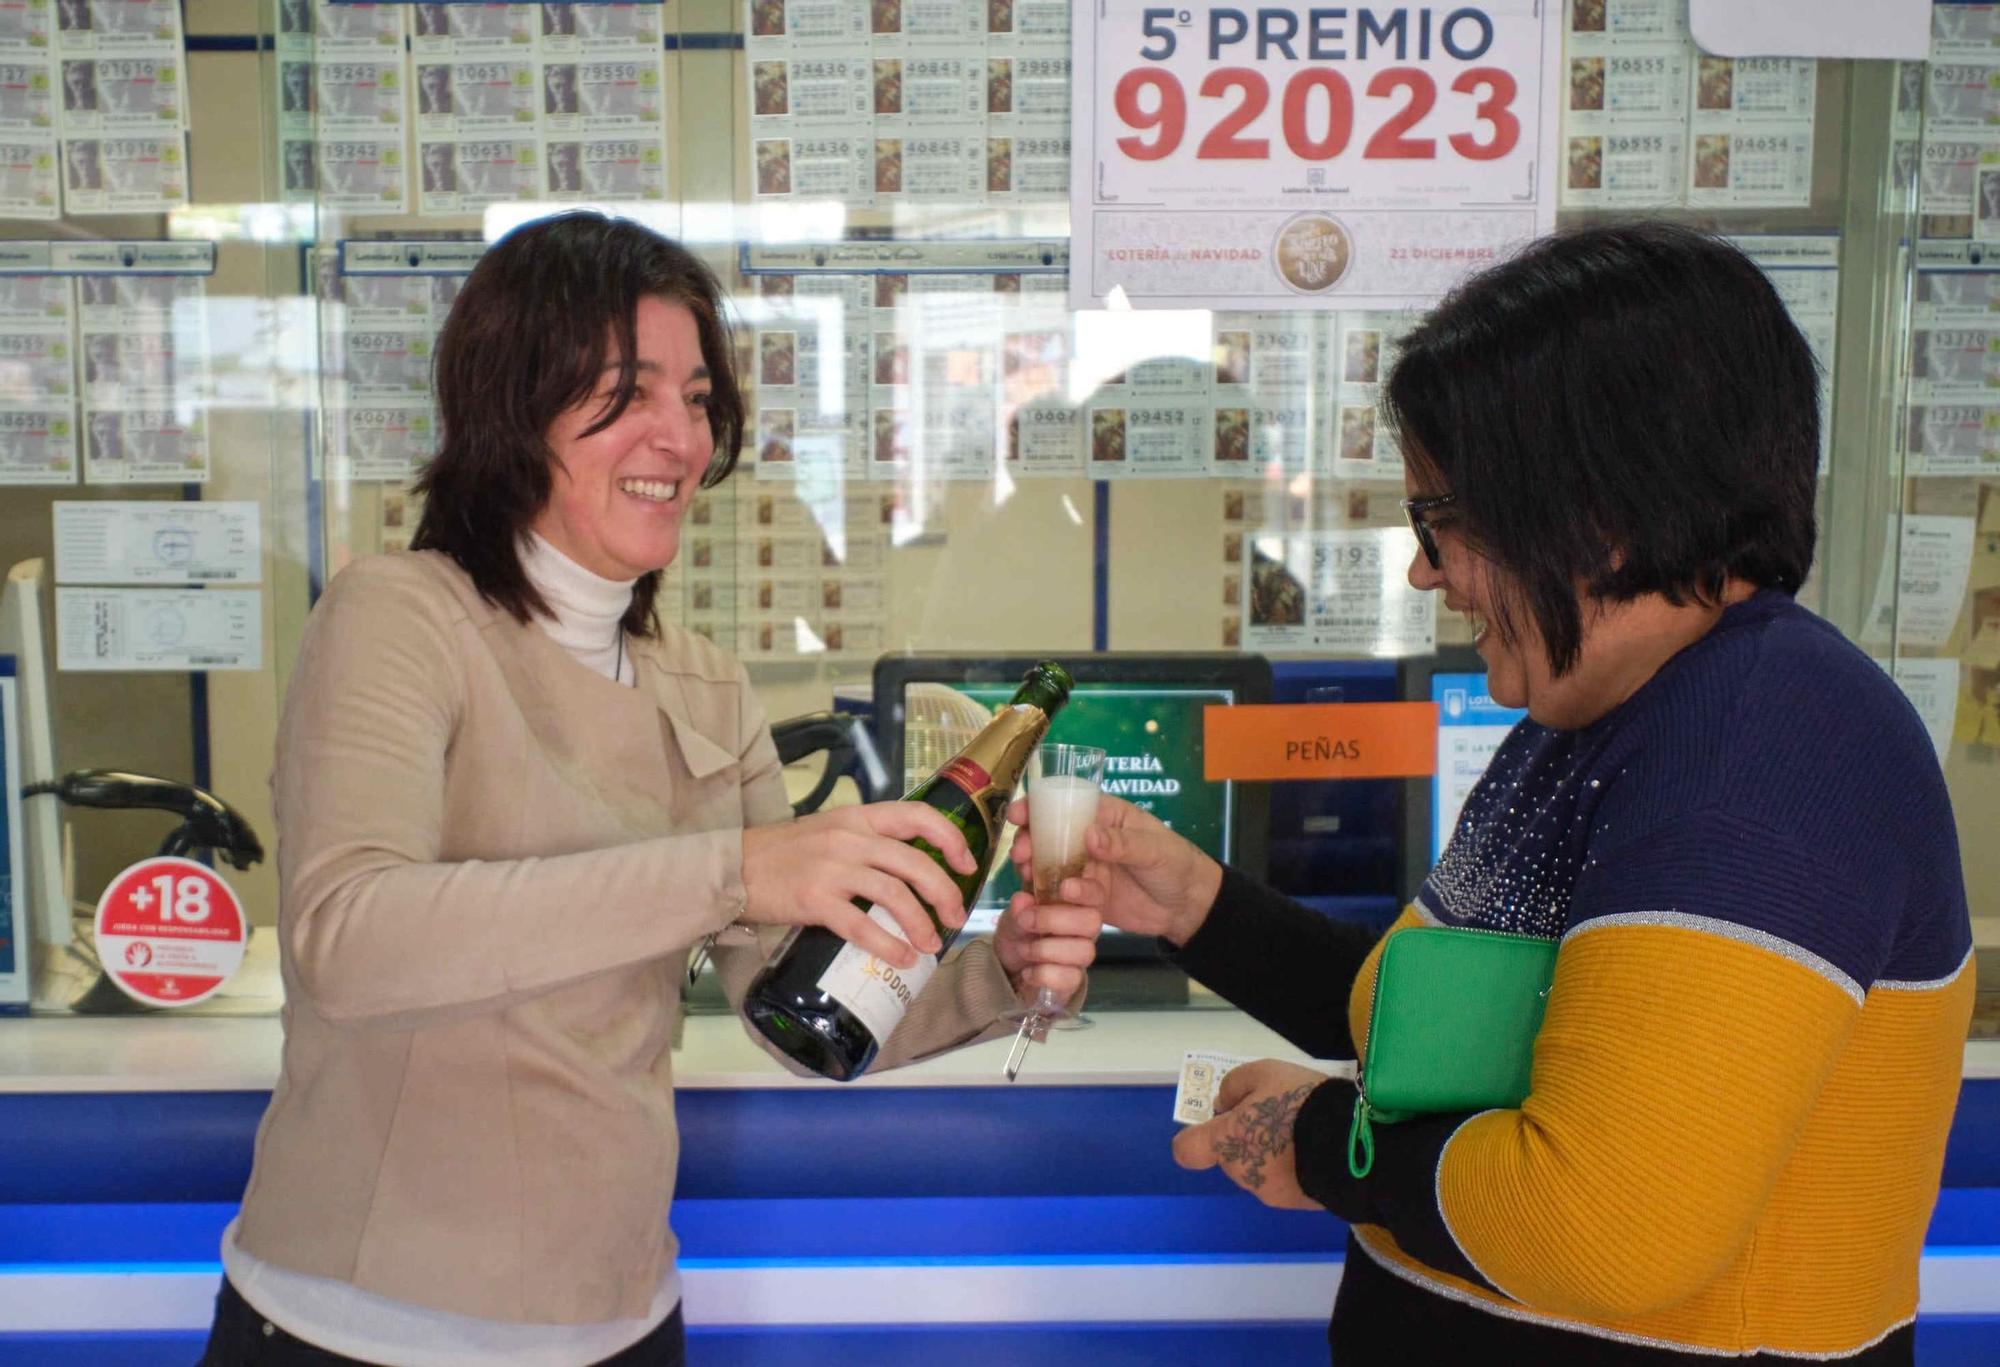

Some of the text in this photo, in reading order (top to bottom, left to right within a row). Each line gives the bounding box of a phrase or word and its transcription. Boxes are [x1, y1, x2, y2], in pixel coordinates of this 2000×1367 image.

[1139, 7, 1494, 61] 5º PREMIO
[1114, 66, 1520, 161] 92023
[1108, 243, 1170, 261] LOTERÍA
[1191, 248, 1262, 261] NAVIDAD
[1389, 247, 1495, 260] 22 DICIEMBRE
[1286, 736, 1360, 761] PEÑAS
[128, 874, 211, 922] +18
